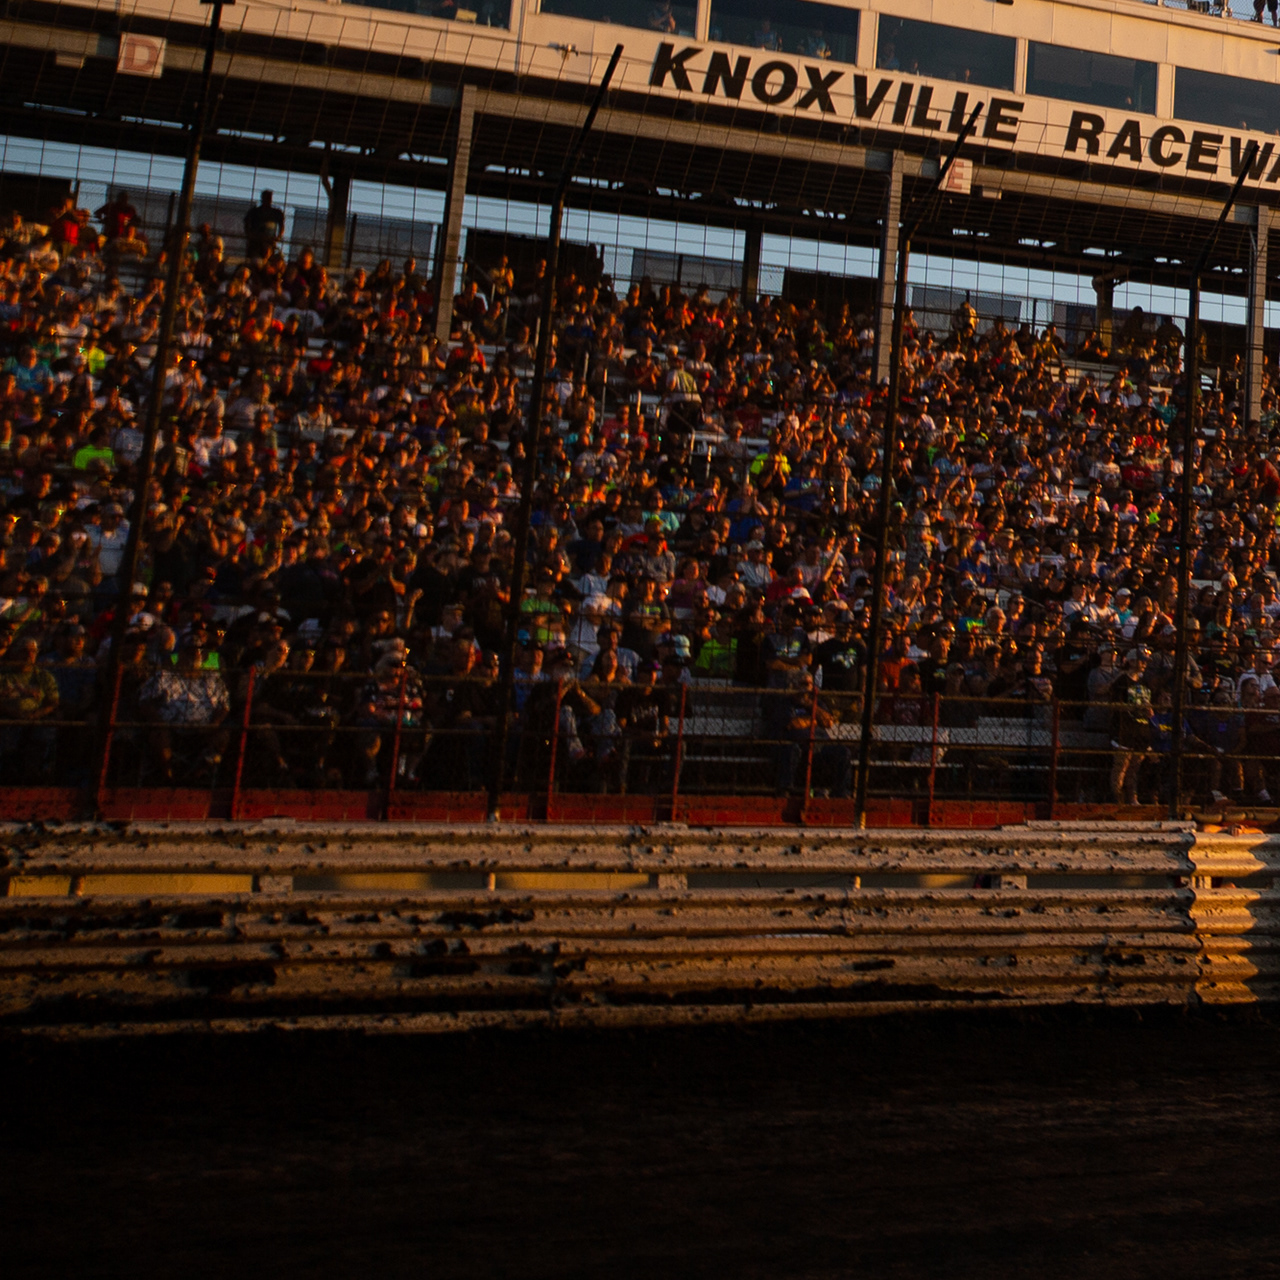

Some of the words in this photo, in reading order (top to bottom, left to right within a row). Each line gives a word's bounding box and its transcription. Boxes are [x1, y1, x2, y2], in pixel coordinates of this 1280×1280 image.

[123, 37, 159, 72] D
[649, 41, 1025, 143] KNOXVILLE
[947, 161, 964, 190] E
